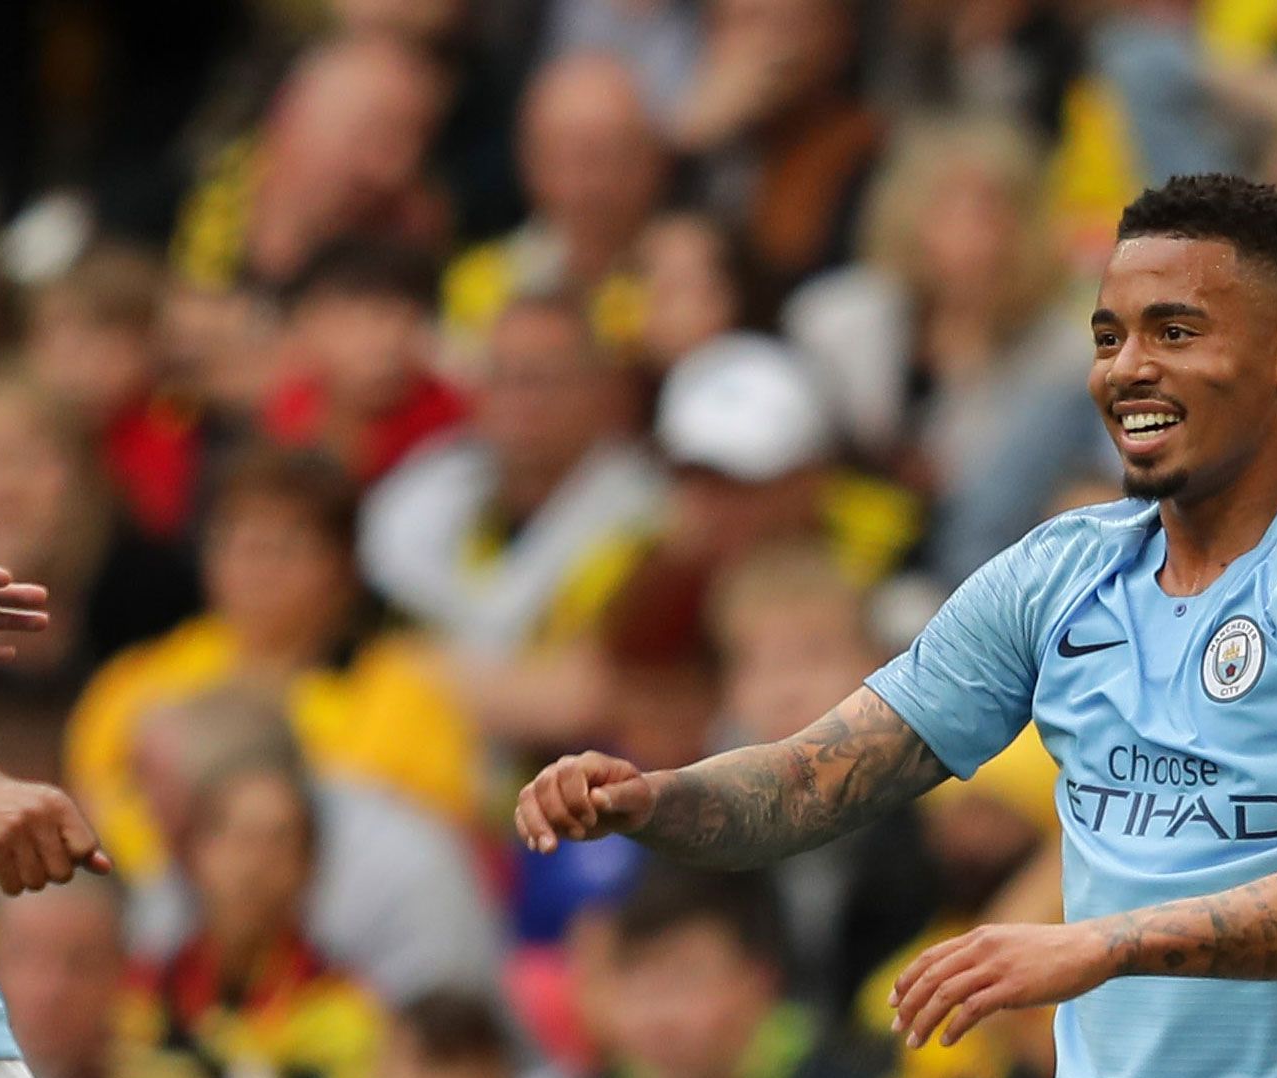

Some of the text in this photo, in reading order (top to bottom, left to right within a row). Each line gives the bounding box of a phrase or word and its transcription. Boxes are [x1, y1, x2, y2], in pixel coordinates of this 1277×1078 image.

[1209, 621, 1258, 652] MANCHESTER
[1220, 685, 1240, 697] CITY
[1109, 744, 1219, 787] Choose
